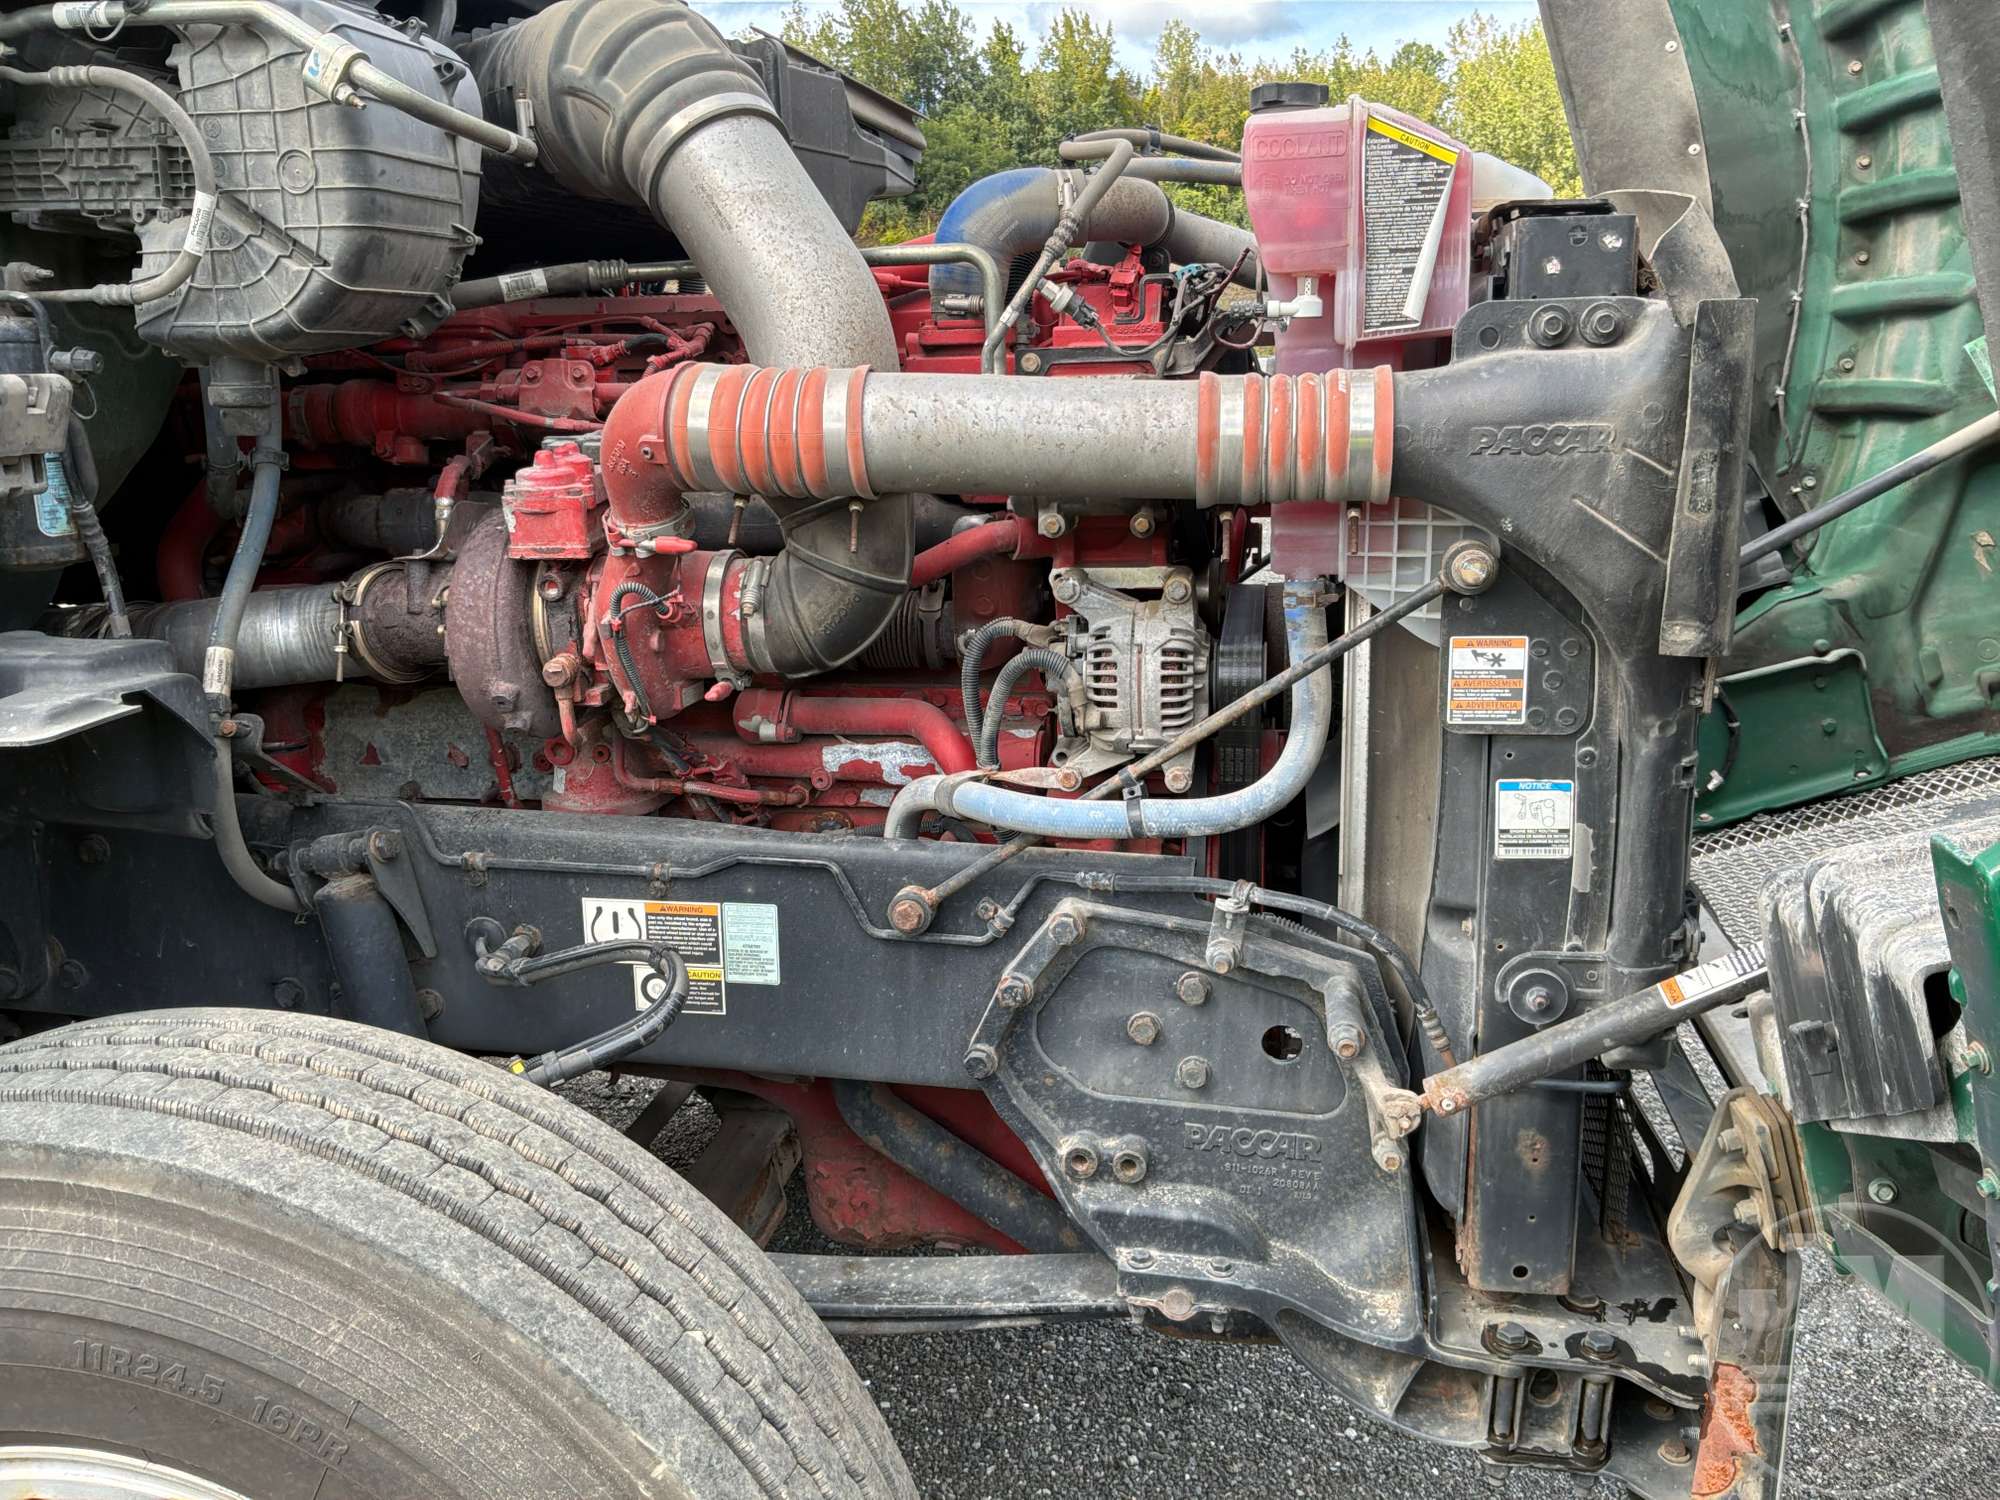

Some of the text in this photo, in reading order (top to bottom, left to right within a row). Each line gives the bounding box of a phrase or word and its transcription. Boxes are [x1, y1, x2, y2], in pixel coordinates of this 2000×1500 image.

[1257, 136, 1344, 158] COOLANT
[1400, 134, 1431, 151] CAUTION
[1468, 423, 1618, 457] PACCAR
[1476, 639, 1512, 647] WARNING
[1466, 701, 1518, 709] ADVERTENCIA
[1519, 782, 1553, 790] NOTICE
[665, 904, 704, 913] WARNING
[1184, 1122, 1322, 1164] PACCAR
[73, 1338, 226, 1406] 11R24.5
[250, 1393, 351, 1468] 16PR
